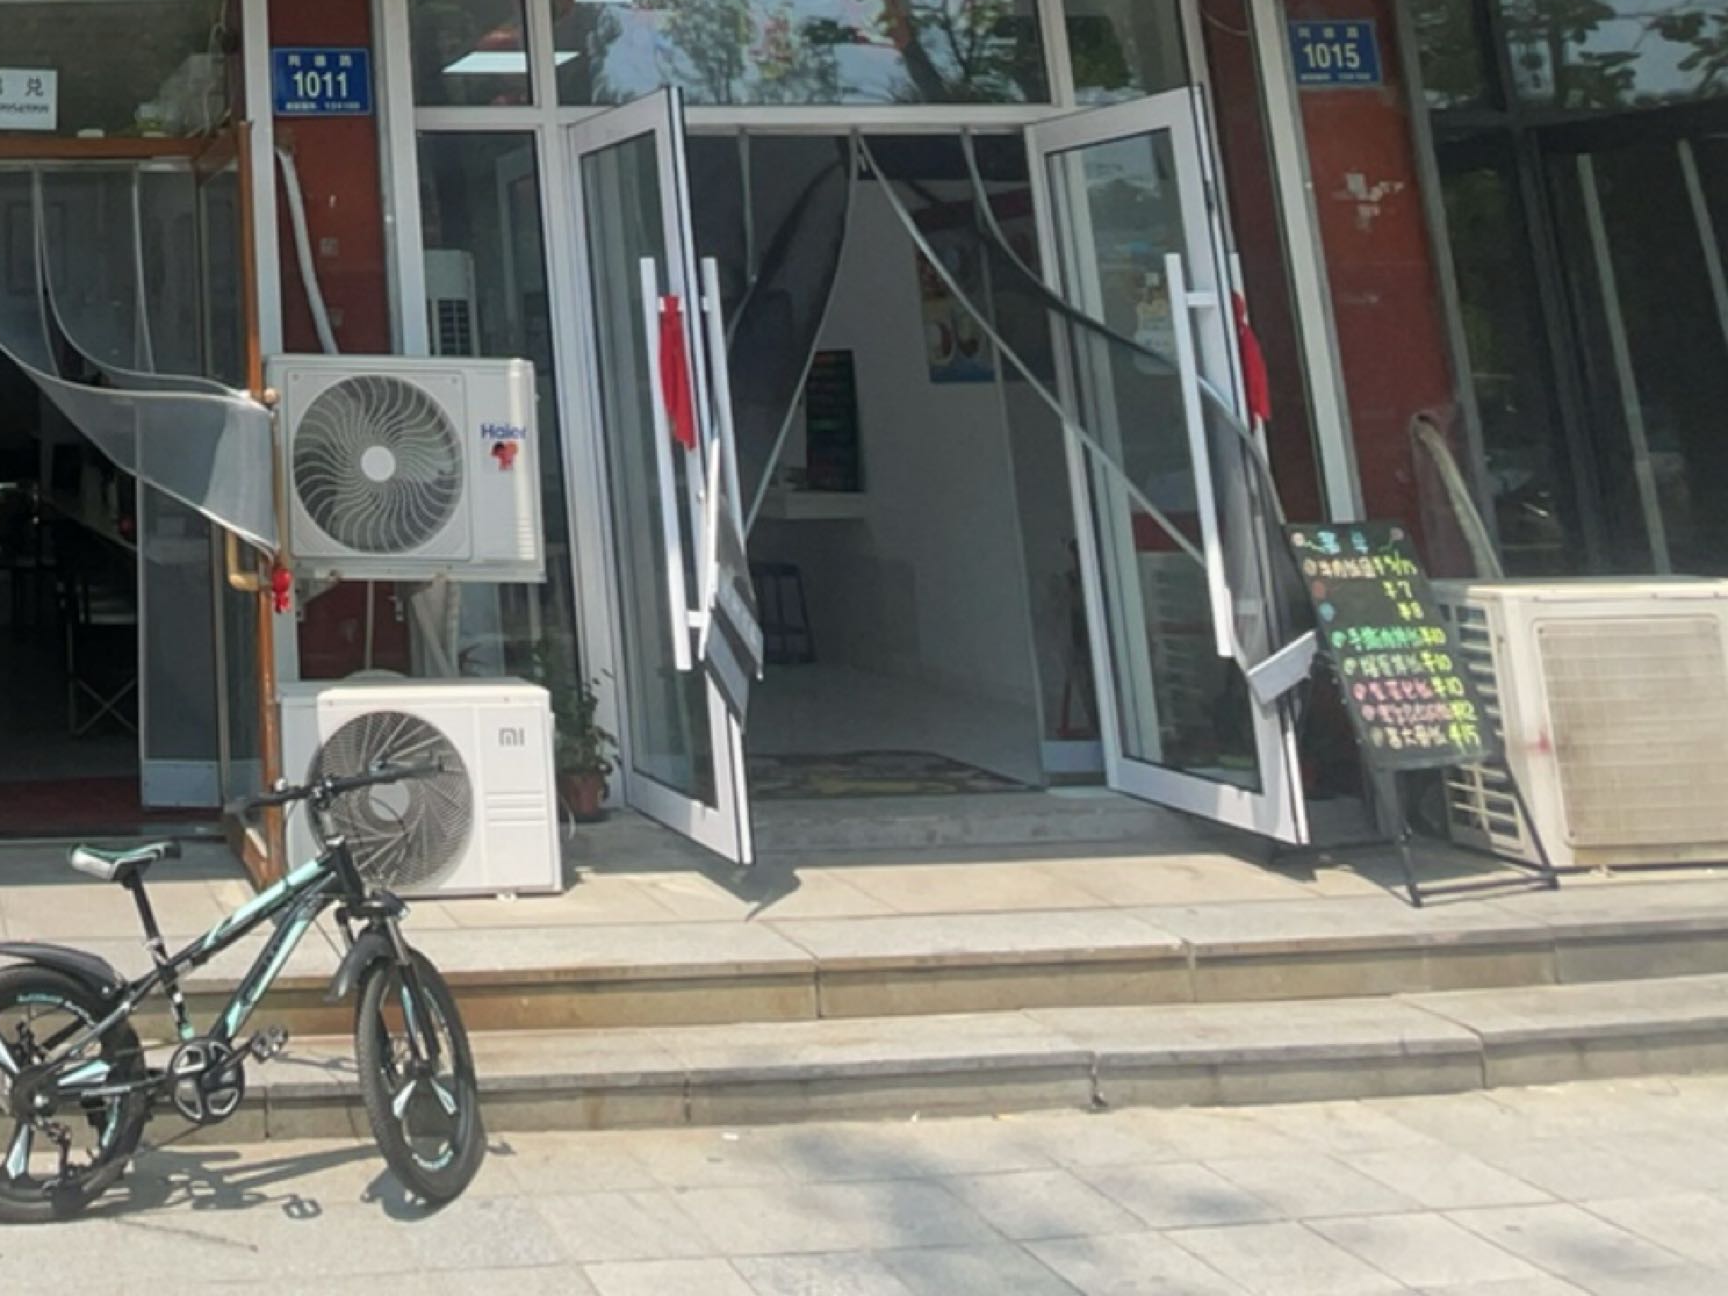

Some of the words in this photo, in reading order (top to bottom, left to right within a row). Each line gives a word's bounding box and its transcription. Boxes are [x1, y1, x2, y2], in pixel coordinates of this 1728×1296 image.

[1302, 42, 1360, 69] 1015
[292, 70, 348, 99] 1011
[480, 422, 527, 440] Haier
